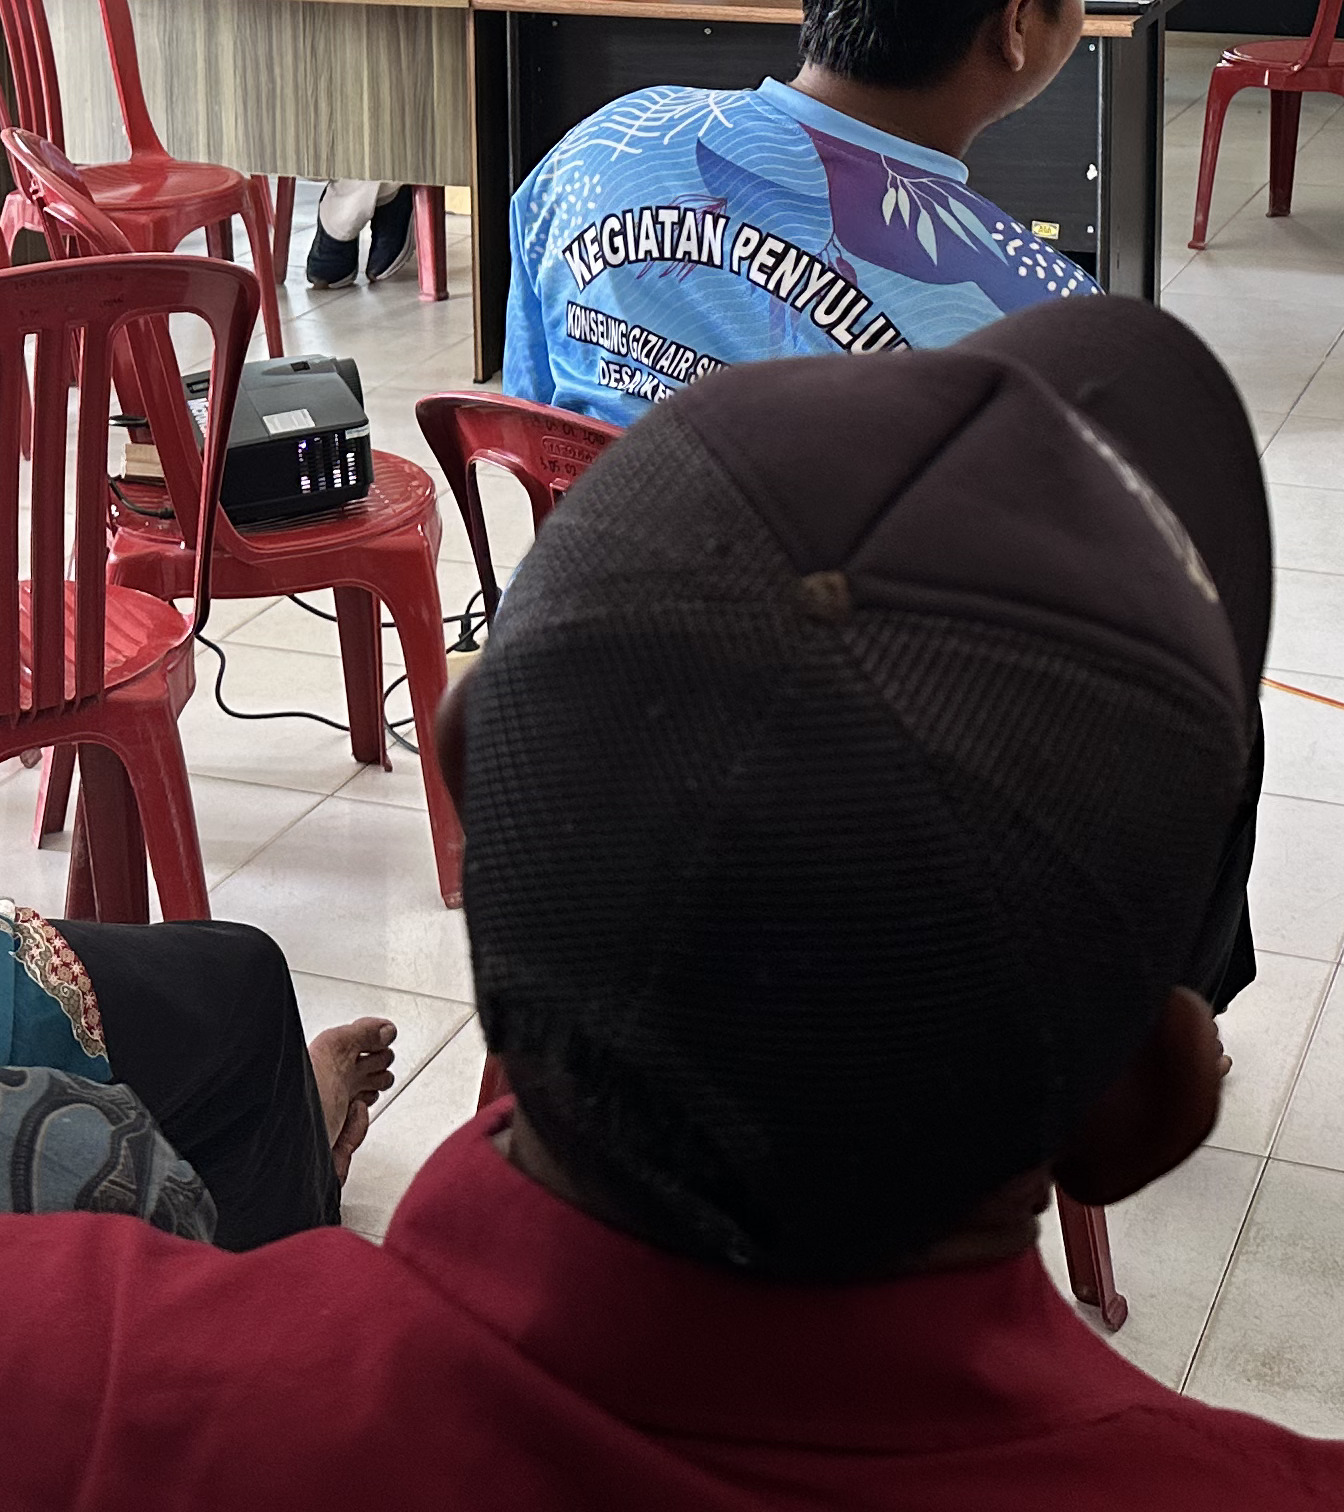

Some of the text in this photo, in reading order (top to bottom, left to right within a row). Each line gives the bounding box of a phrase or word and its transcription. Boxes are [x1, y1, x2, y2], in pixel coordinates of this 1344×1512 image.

[563, 205, 913, 355] KEGIATAN PENYULU
[567, 301, 629, 357] KONSELING
[628, 325, 667, 371] GIZI
[656, 340, 698, 383] AIR
[597, 356, 643, 395] DESA
